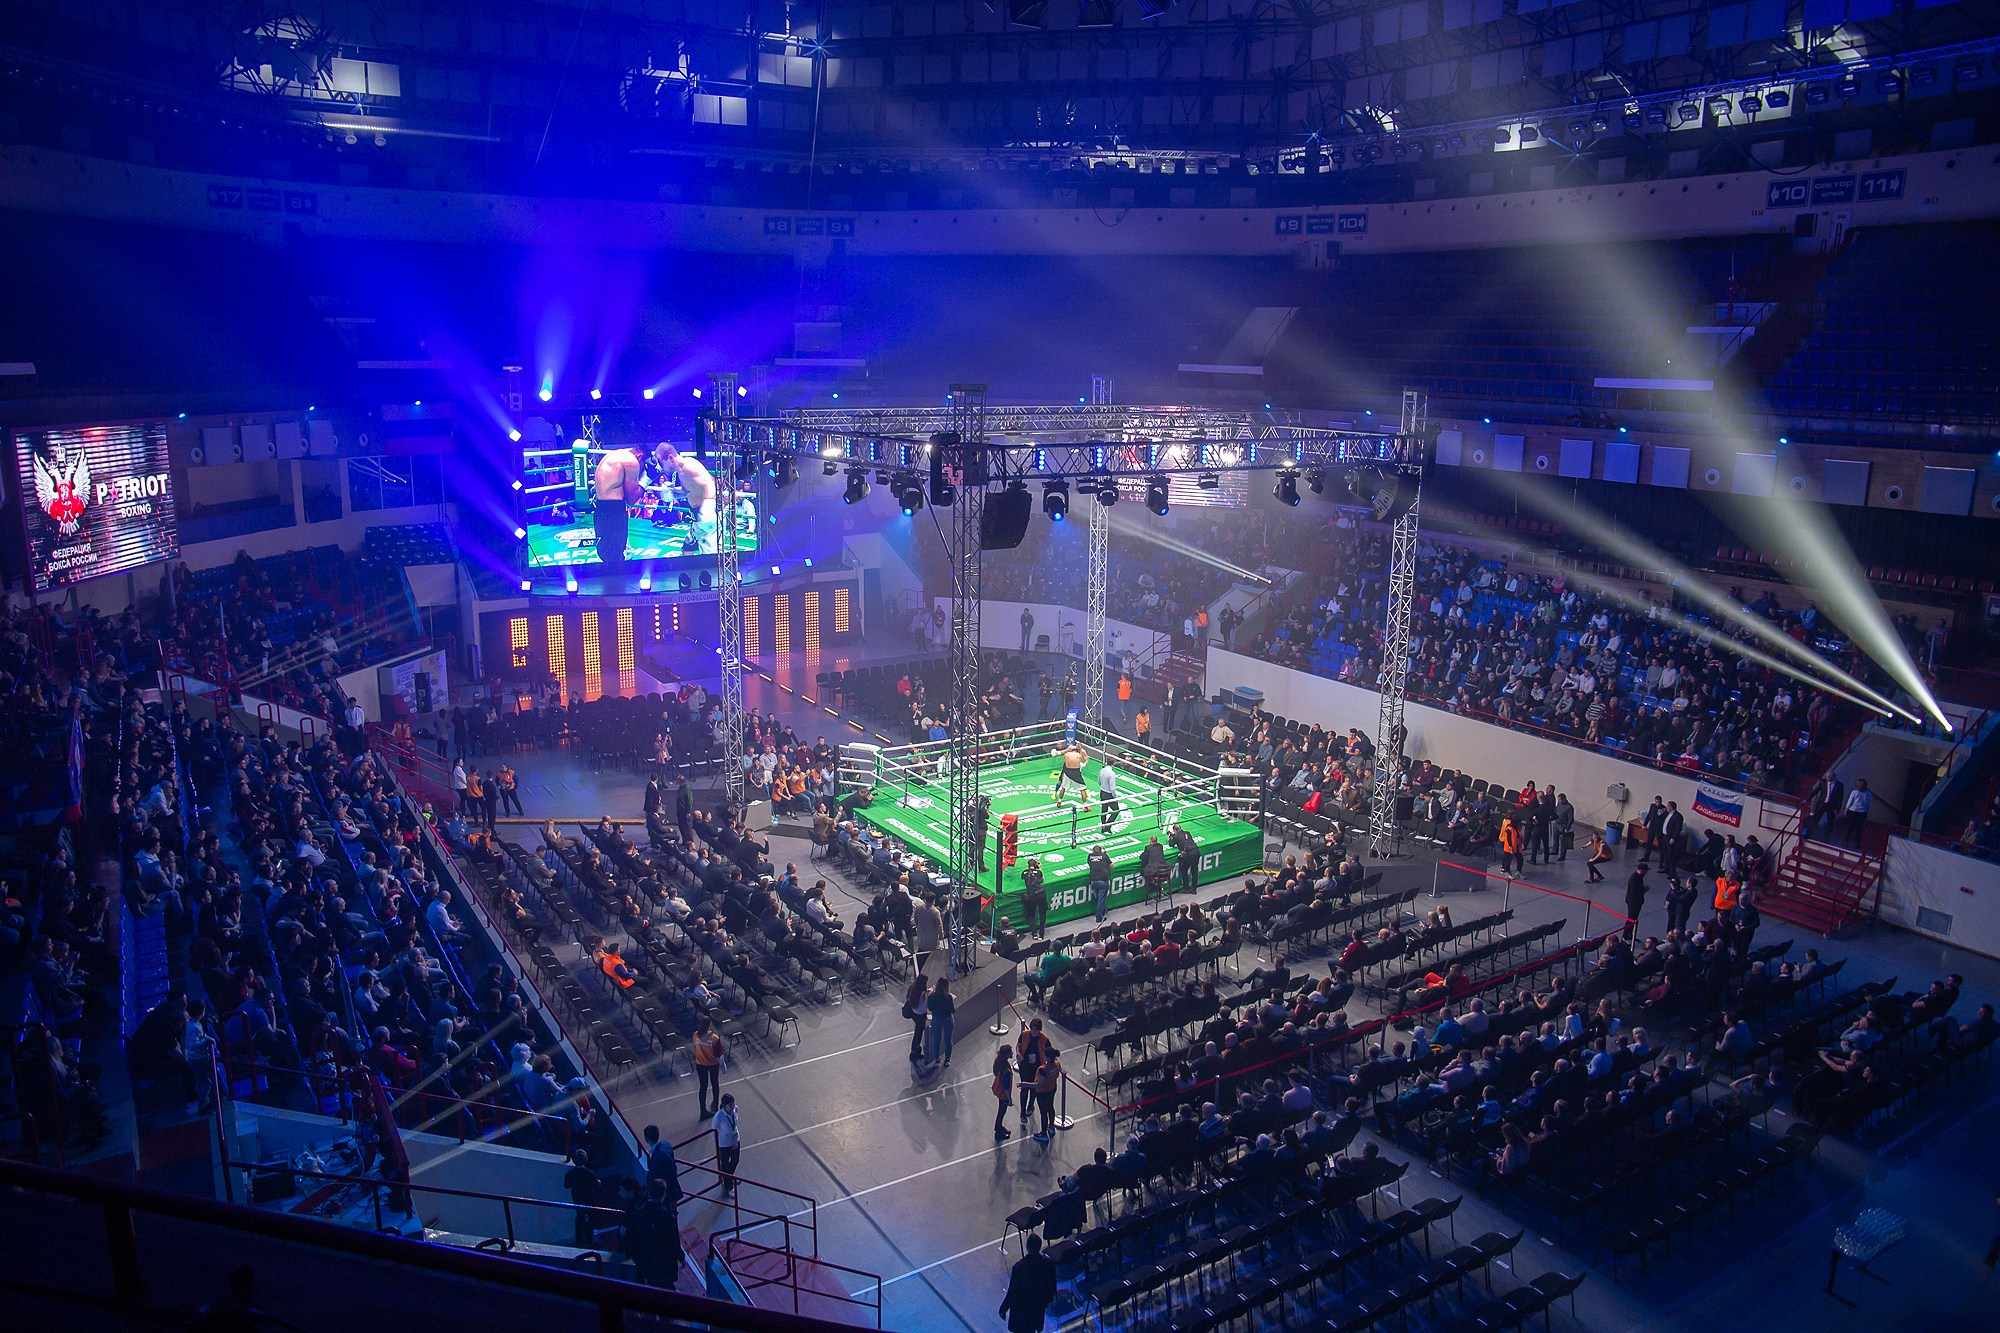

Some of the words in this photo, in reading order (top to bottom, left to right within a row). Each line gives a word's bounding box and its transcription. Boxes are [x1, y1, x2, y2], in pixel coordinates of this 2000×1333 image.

[1864, 177, 1887, 194] 11
[1781, 186, 1806, 201] 10
[1288, 220, 1299, 231] 9
[1340, 218, 1358, 229] 10
[1117, 477, 1148, 486] ФЕДЕРАЦ
[121, 503, 152, 518] BOXING
[52, 542, 92, 559] ФЕДЕРАЦИЯ
[48, 559, 72, 572] БОКСА
[71, 552, 98, 568] РОССИИ
